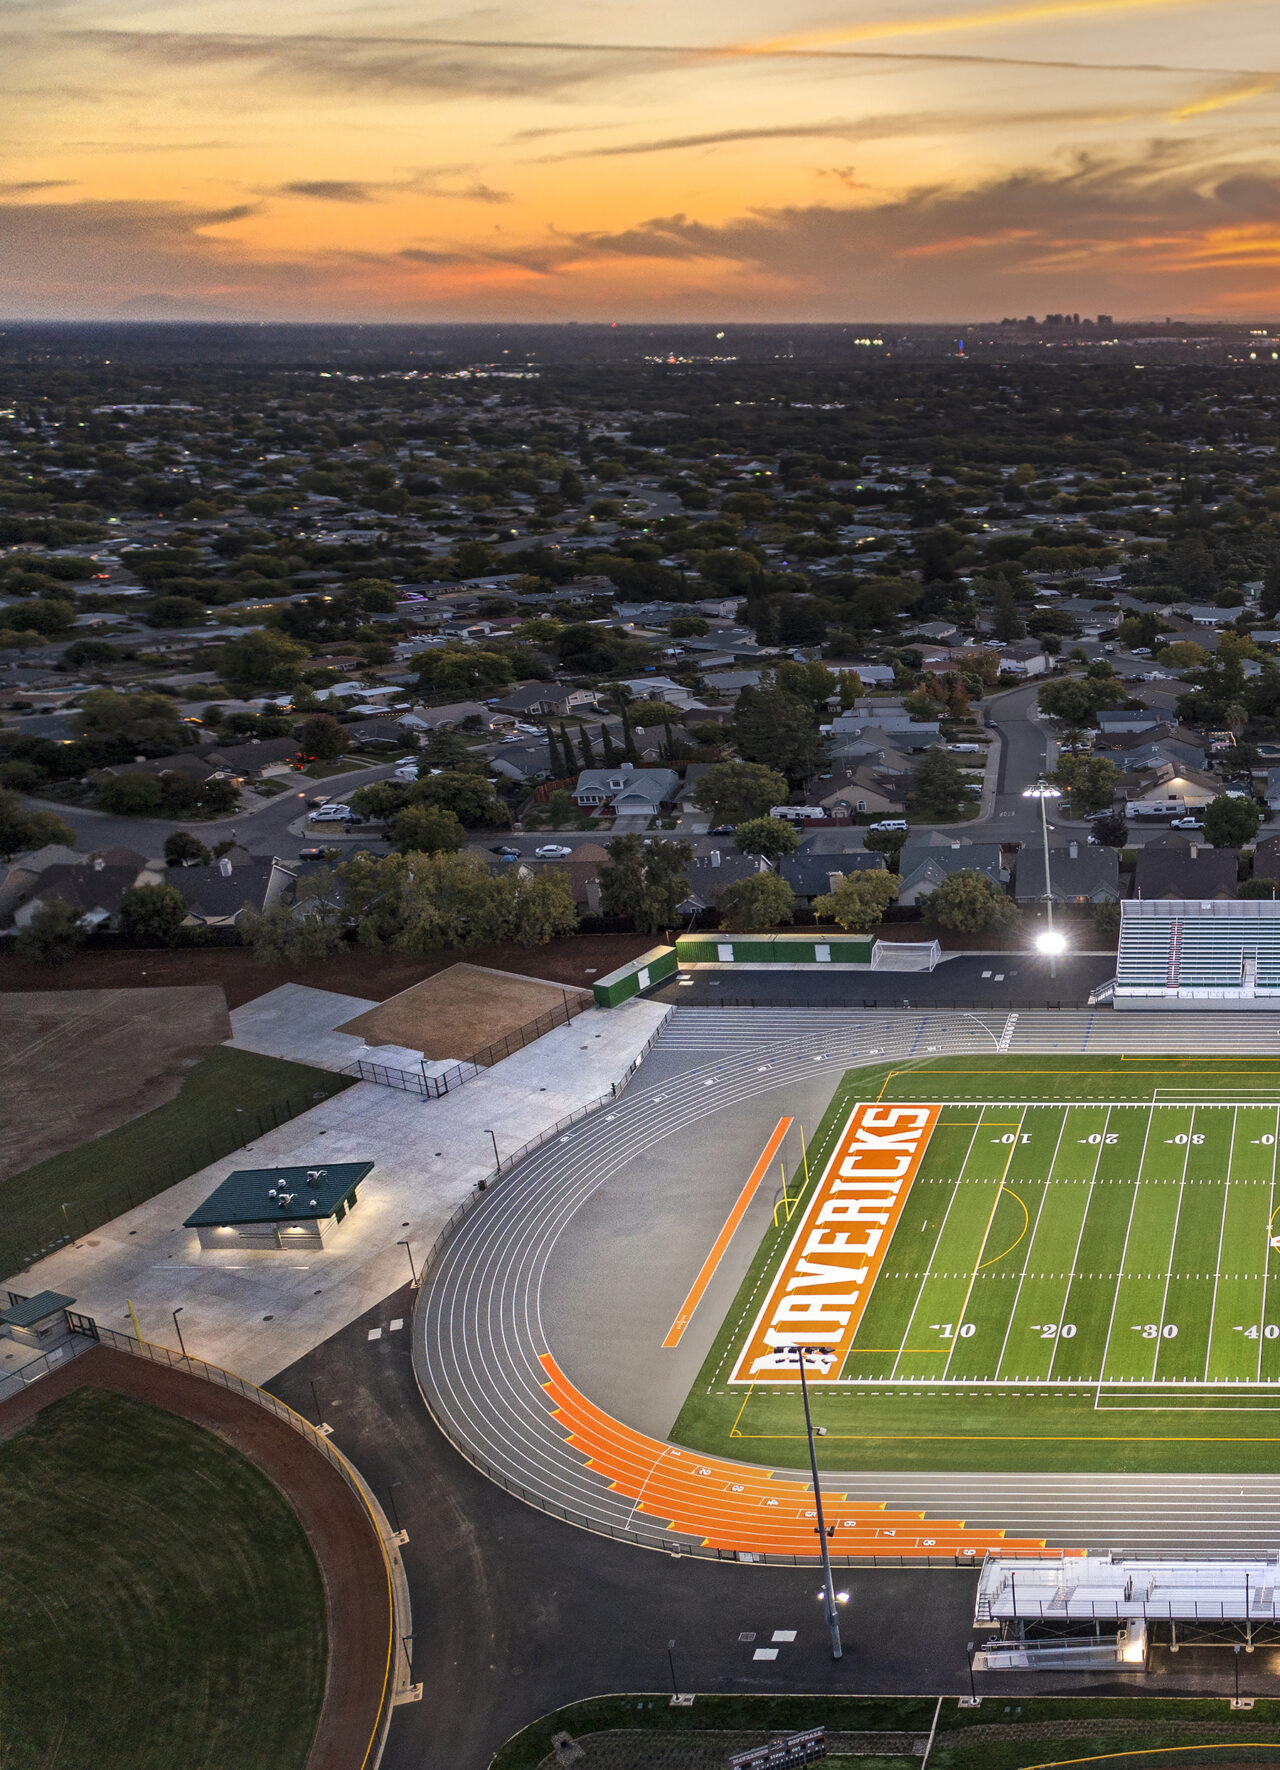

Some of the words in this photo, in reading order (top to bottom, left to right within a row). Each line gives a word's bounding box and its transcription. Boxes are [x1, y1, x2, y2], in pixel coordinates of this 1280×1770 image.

[1001, 1133, 1033, 1145] 10
[1087, 1133, 1120, 1145] 20
[1174, 1133, 1206, 1145] 30
[749, 1106, 930, 1375] MAVERICKS
[938, 1323, 977, 1340] 10
[1040, 1323, 1077, 1340] 20
[1142, 1323, 1179, 1340] 30
[1243, 1323, 1280, 1340] 40
[670, 1449, 681, 1457] 1
[699, 1467, 711, 1476] 2
[731, 1484, 744, 1492] 3
[767, 1499, 779, 1507] 4
[883, 1529, 896, 1537] 7
[963, 1548, 976, 1556] 9
